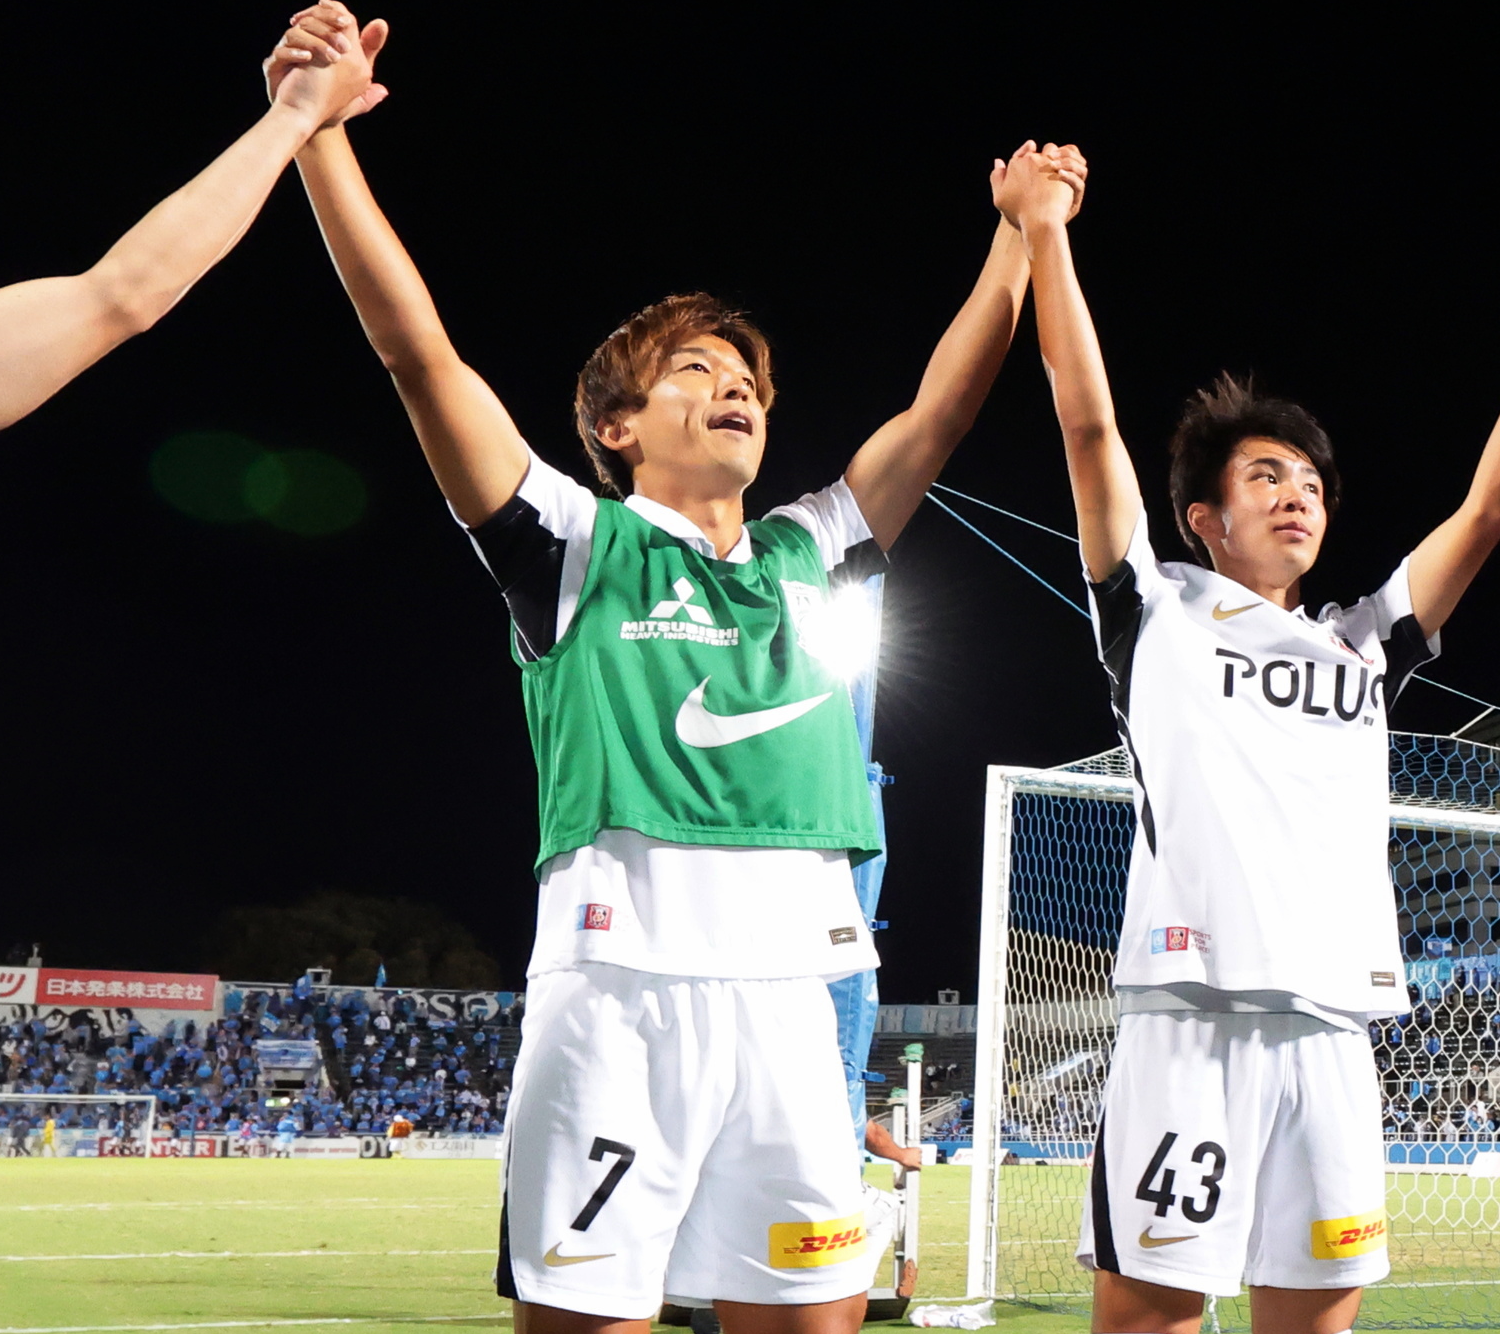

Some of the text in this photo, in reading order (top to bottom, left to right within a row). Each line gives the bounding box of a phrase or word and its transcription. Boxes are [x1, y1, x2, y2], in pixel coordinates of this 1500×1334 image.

[620, 620, 739, 639] MITSUBISHI
[620, 631, 739, 647] HEAVY INDUSTRIES
[46, 978, 205, 1002] 日本発条株式会社
[569, 1136, 636, 1232] 7
[1135, 1131, 1227, 1223] 43
[799, 1227, 867, 1254] DHL
